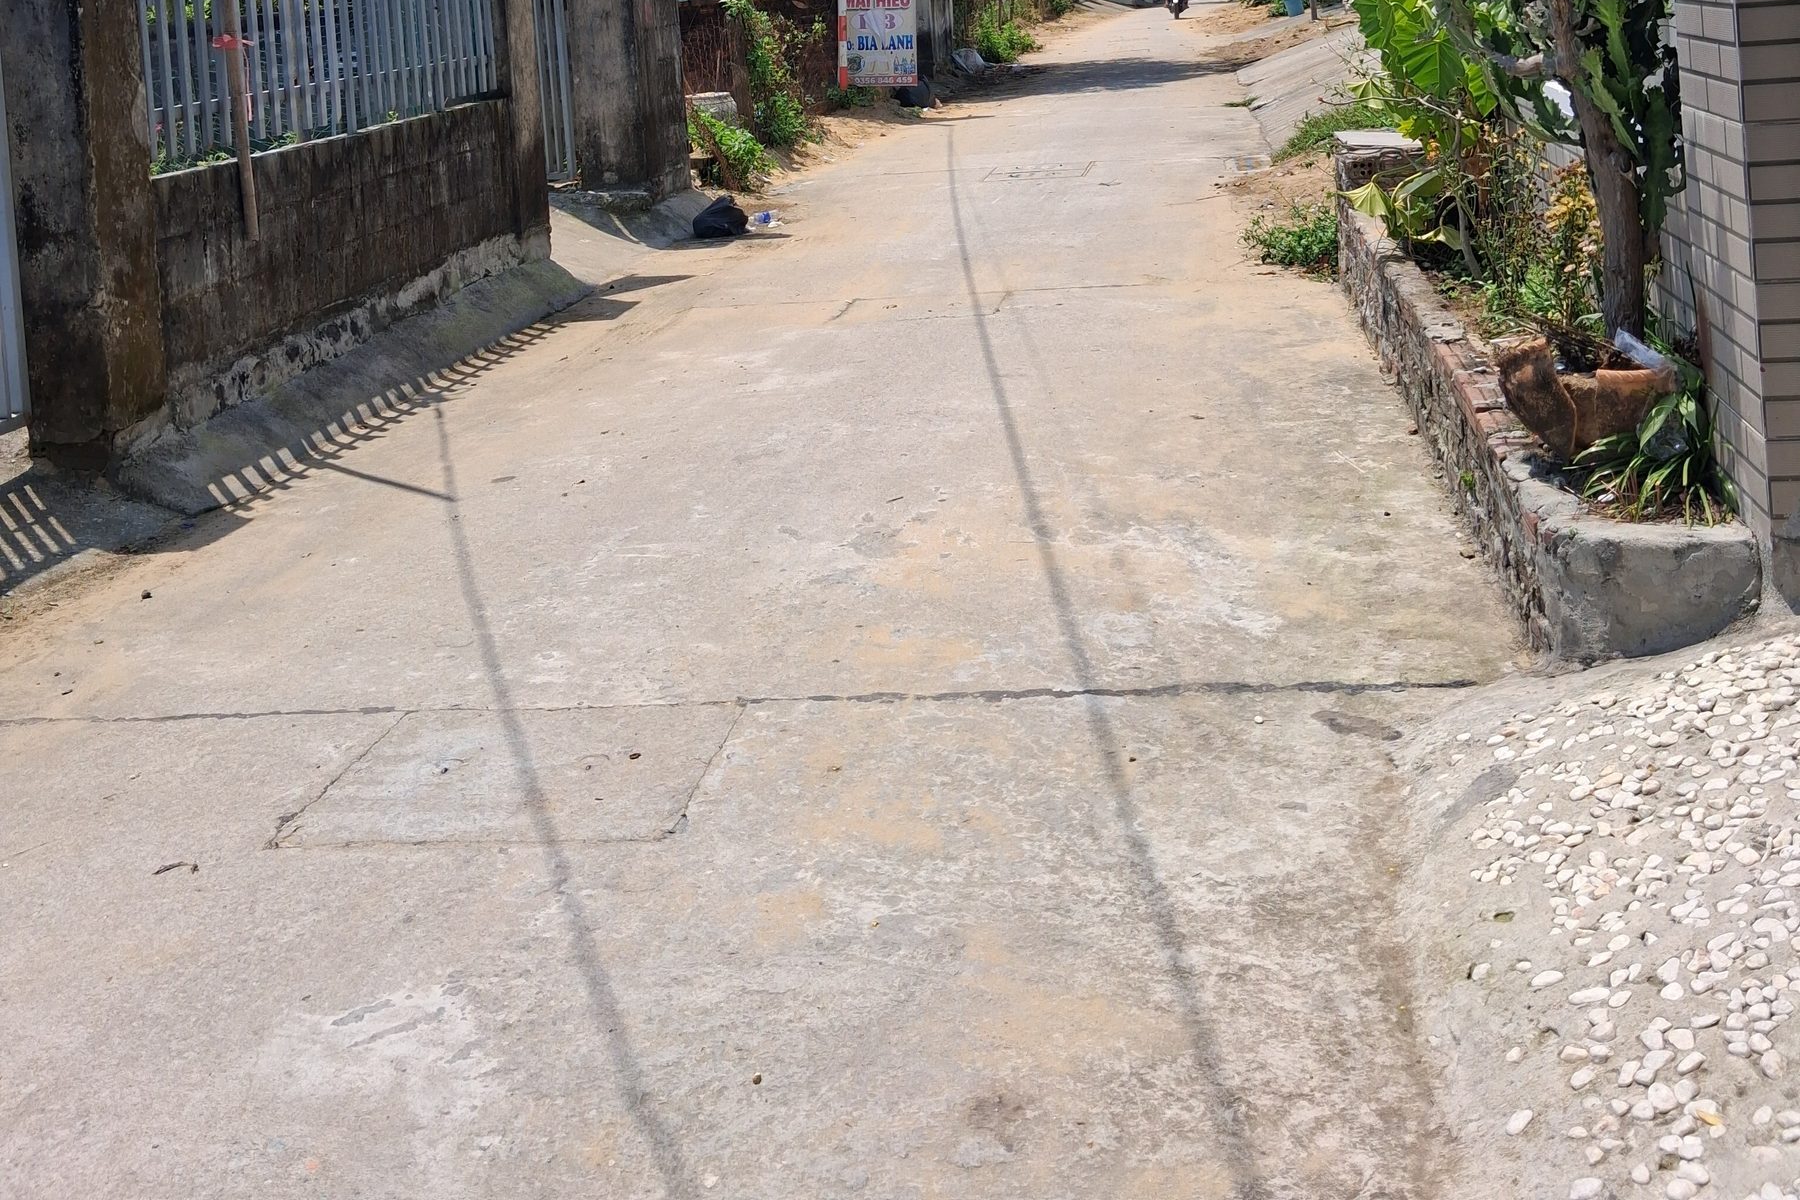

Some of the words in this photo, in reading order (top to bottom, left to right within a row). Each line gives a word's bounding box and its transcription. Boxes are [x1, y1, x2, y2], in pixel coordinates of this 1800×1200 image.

[858, 13, 896, 30] 13
[857, 35, 878, 51] BIA
[896, 75, 913, 84] 459
